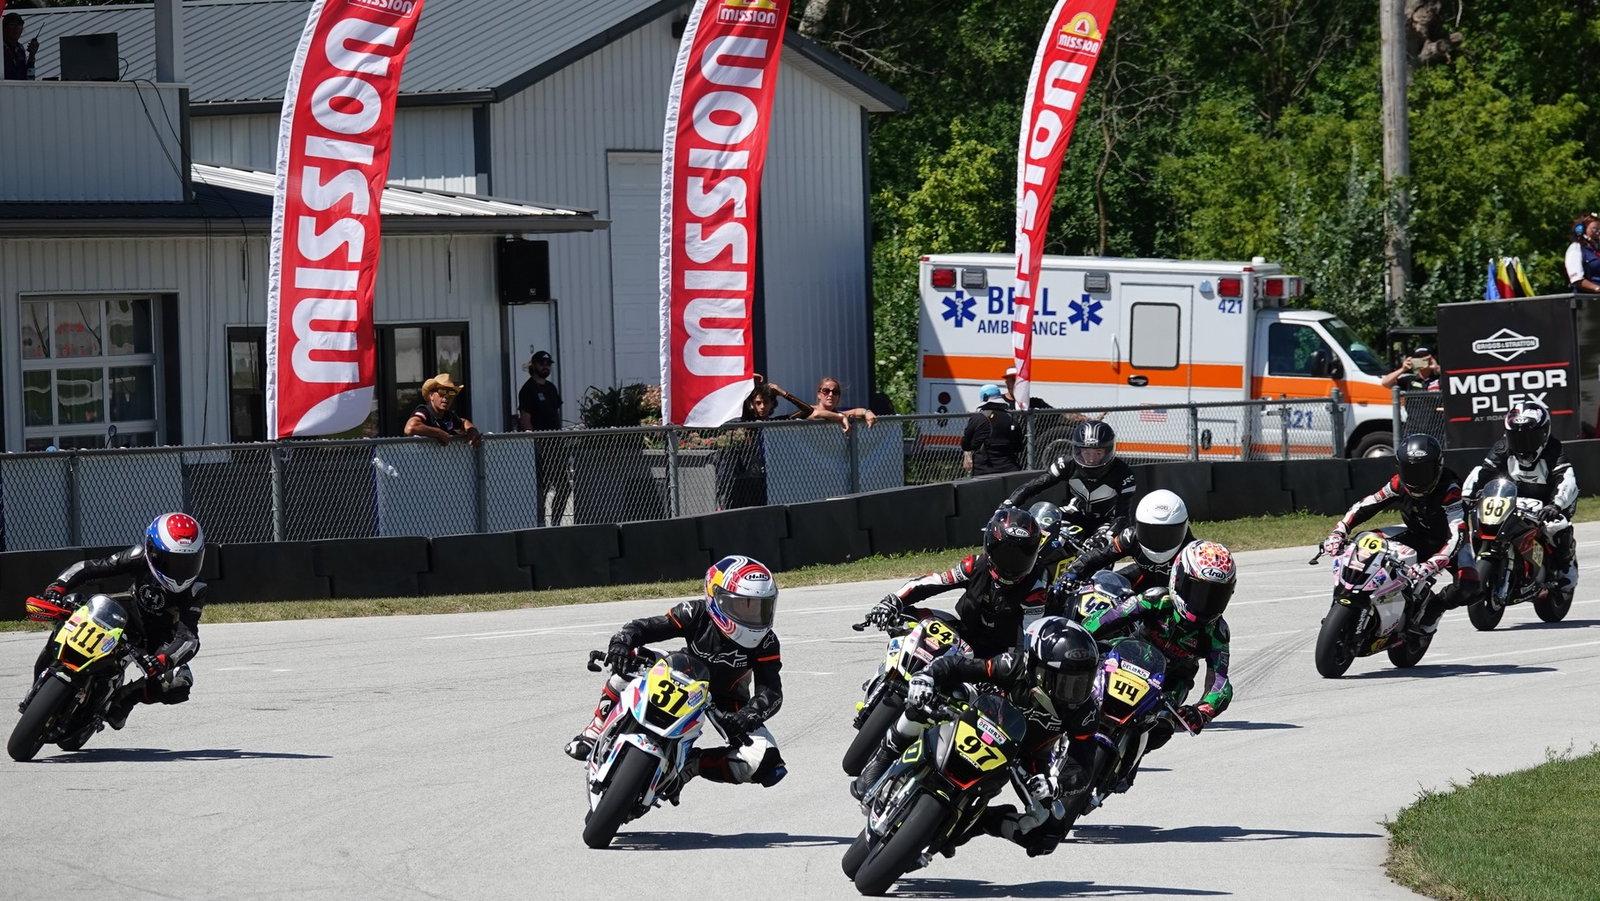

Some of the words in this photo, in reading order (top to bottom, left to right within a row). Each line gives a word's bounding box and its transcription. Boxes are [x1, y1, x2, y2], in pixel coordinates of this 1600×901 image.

[988, 286, 1057, 316] BEL
[1218, 299, 1243, 314] 421
[977, 319, 1067, 336] AMBANCE
[1449, 369, 1567, 395] MOTOR
[1486, 414, 1506, 422] ROA
[1484, 499, 1506, 517] 98
[1363, 538, 1379, 550] 16
[1205, 569, 1225, 579] Arai
[69, 621, 105, 654] 111
[929, 622, 953, 643] 64
[1114, 680, 1140, 702] 44
[958, 736, 999, 766] 97
